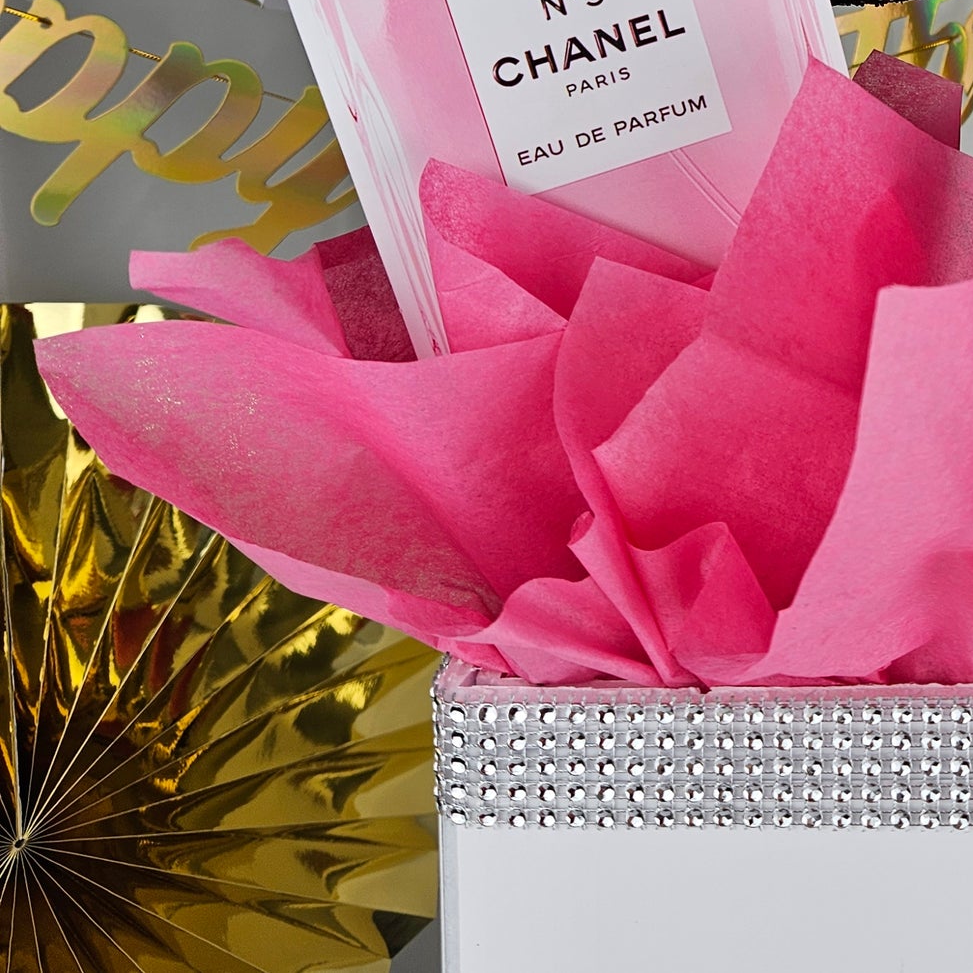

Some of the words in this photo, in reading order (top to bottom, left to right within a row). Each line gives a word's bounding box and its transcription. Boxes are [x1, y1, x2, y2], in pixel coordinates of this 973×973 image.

[492, 9, 686, 87] CHANEL
[566, 67, 631, 97] PARIS
[517, 140, 564, 166] EAU
[575, 127, 606, 148] DE
[613, 95, 708, 136] PARFUM
